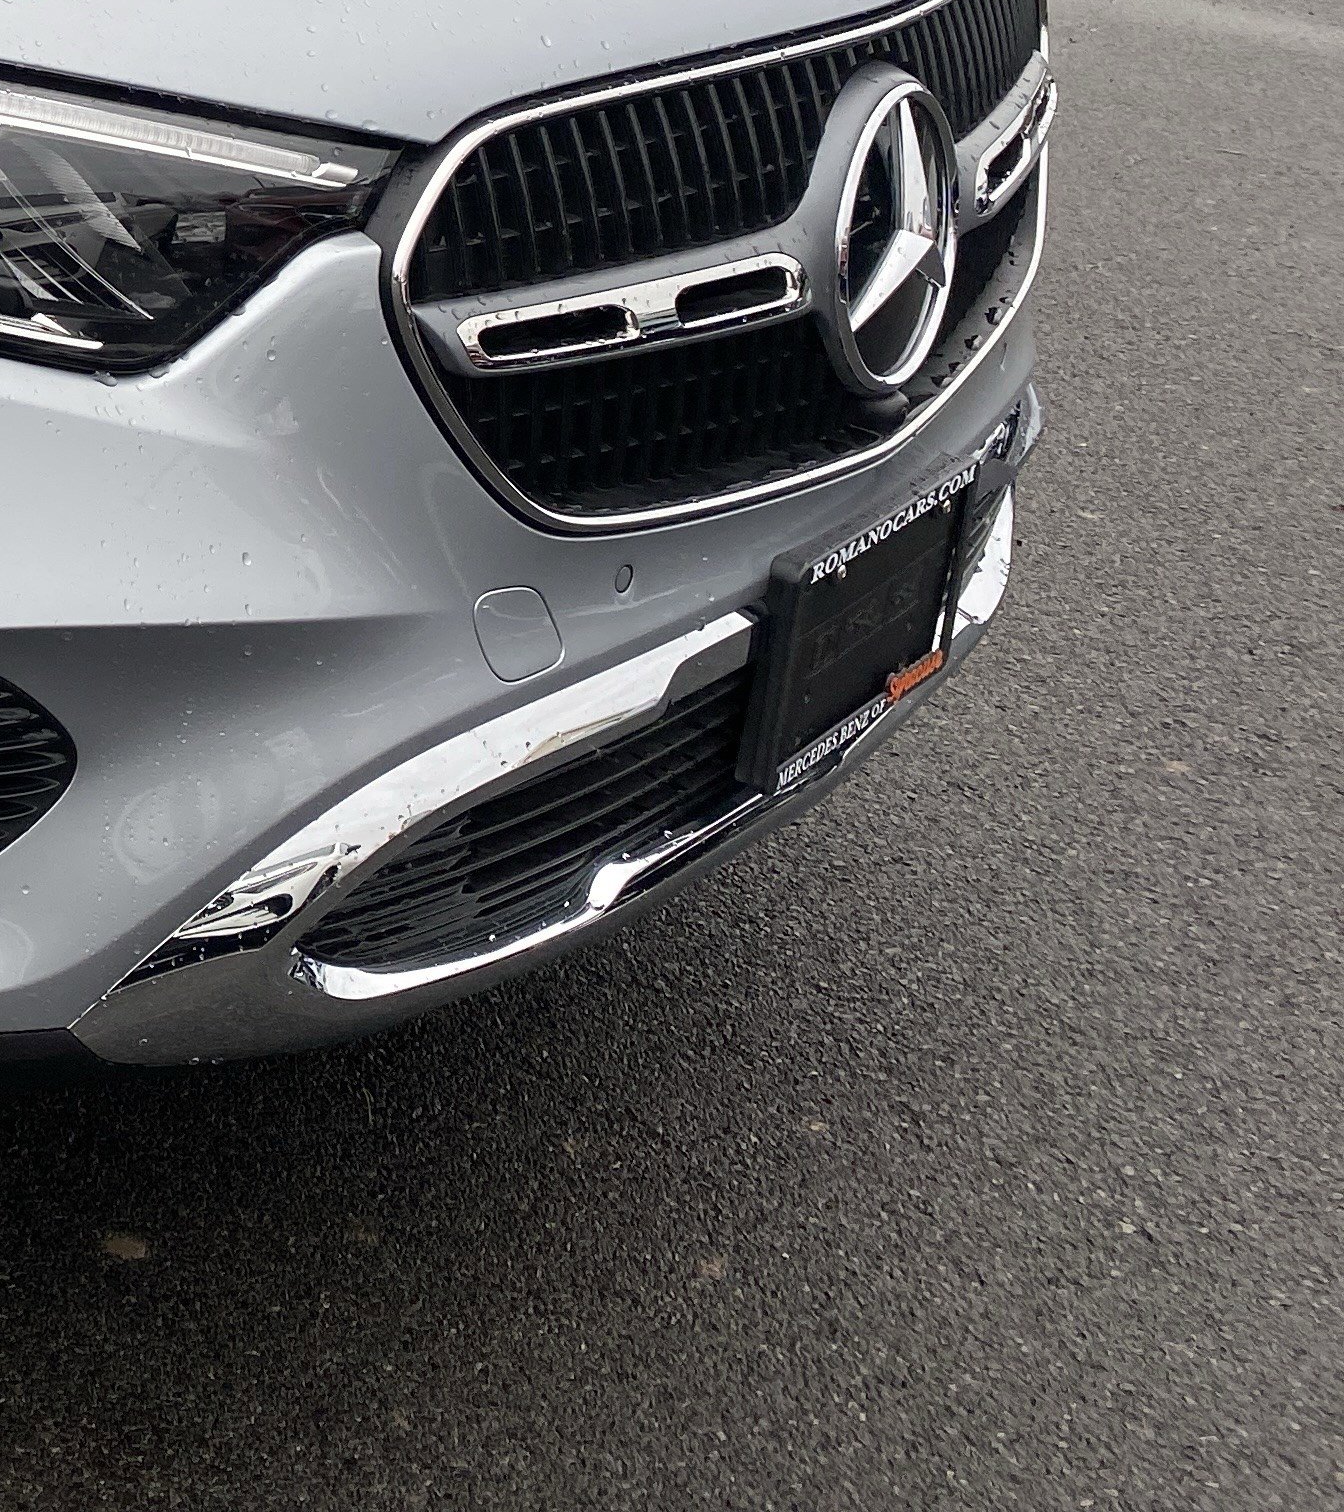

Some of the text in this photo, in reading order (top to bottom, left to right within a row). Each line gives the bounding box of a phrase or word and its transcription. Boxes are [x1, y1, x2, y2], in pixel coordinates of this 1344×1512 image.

[810, 463, 977, 585] ROMANOCARS.COM
[776, 698, 887, 790] MERCEDES BENZ OF
